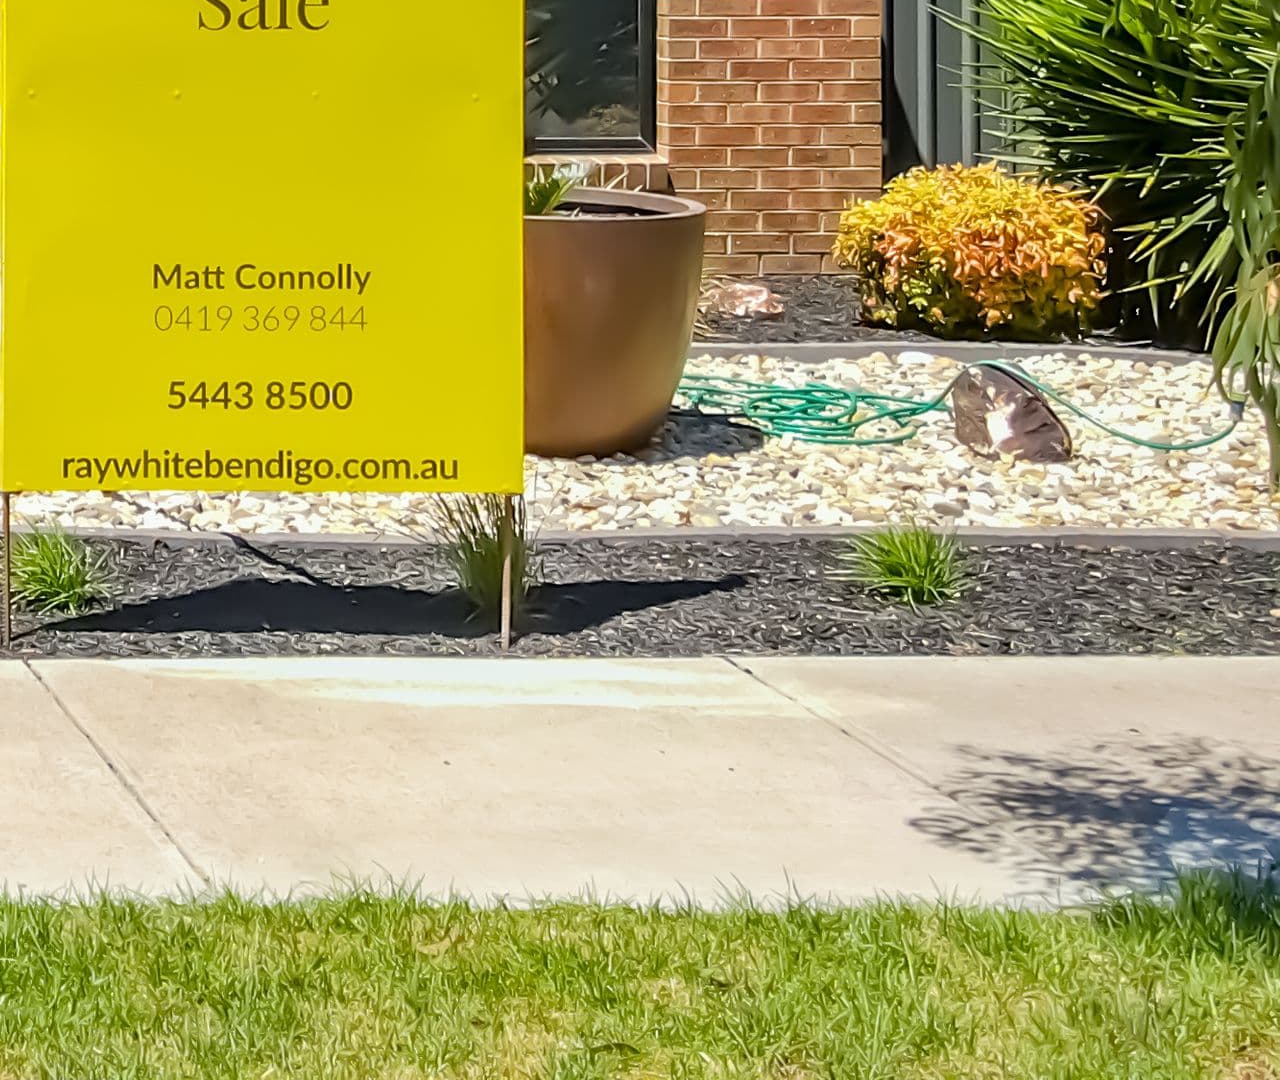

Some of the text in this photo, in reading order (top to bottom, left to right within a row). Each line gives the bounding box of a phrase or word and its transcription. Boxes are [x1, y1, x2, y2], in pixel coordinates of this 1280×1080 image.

[153, 263, 372, 295] Matt Connolly
[154, 305, 368, 332] 0419 369 844
[167, 381, 353, 410] 5443 8500
[62, 449, 459, 486] raywhitebendigo.com.au
